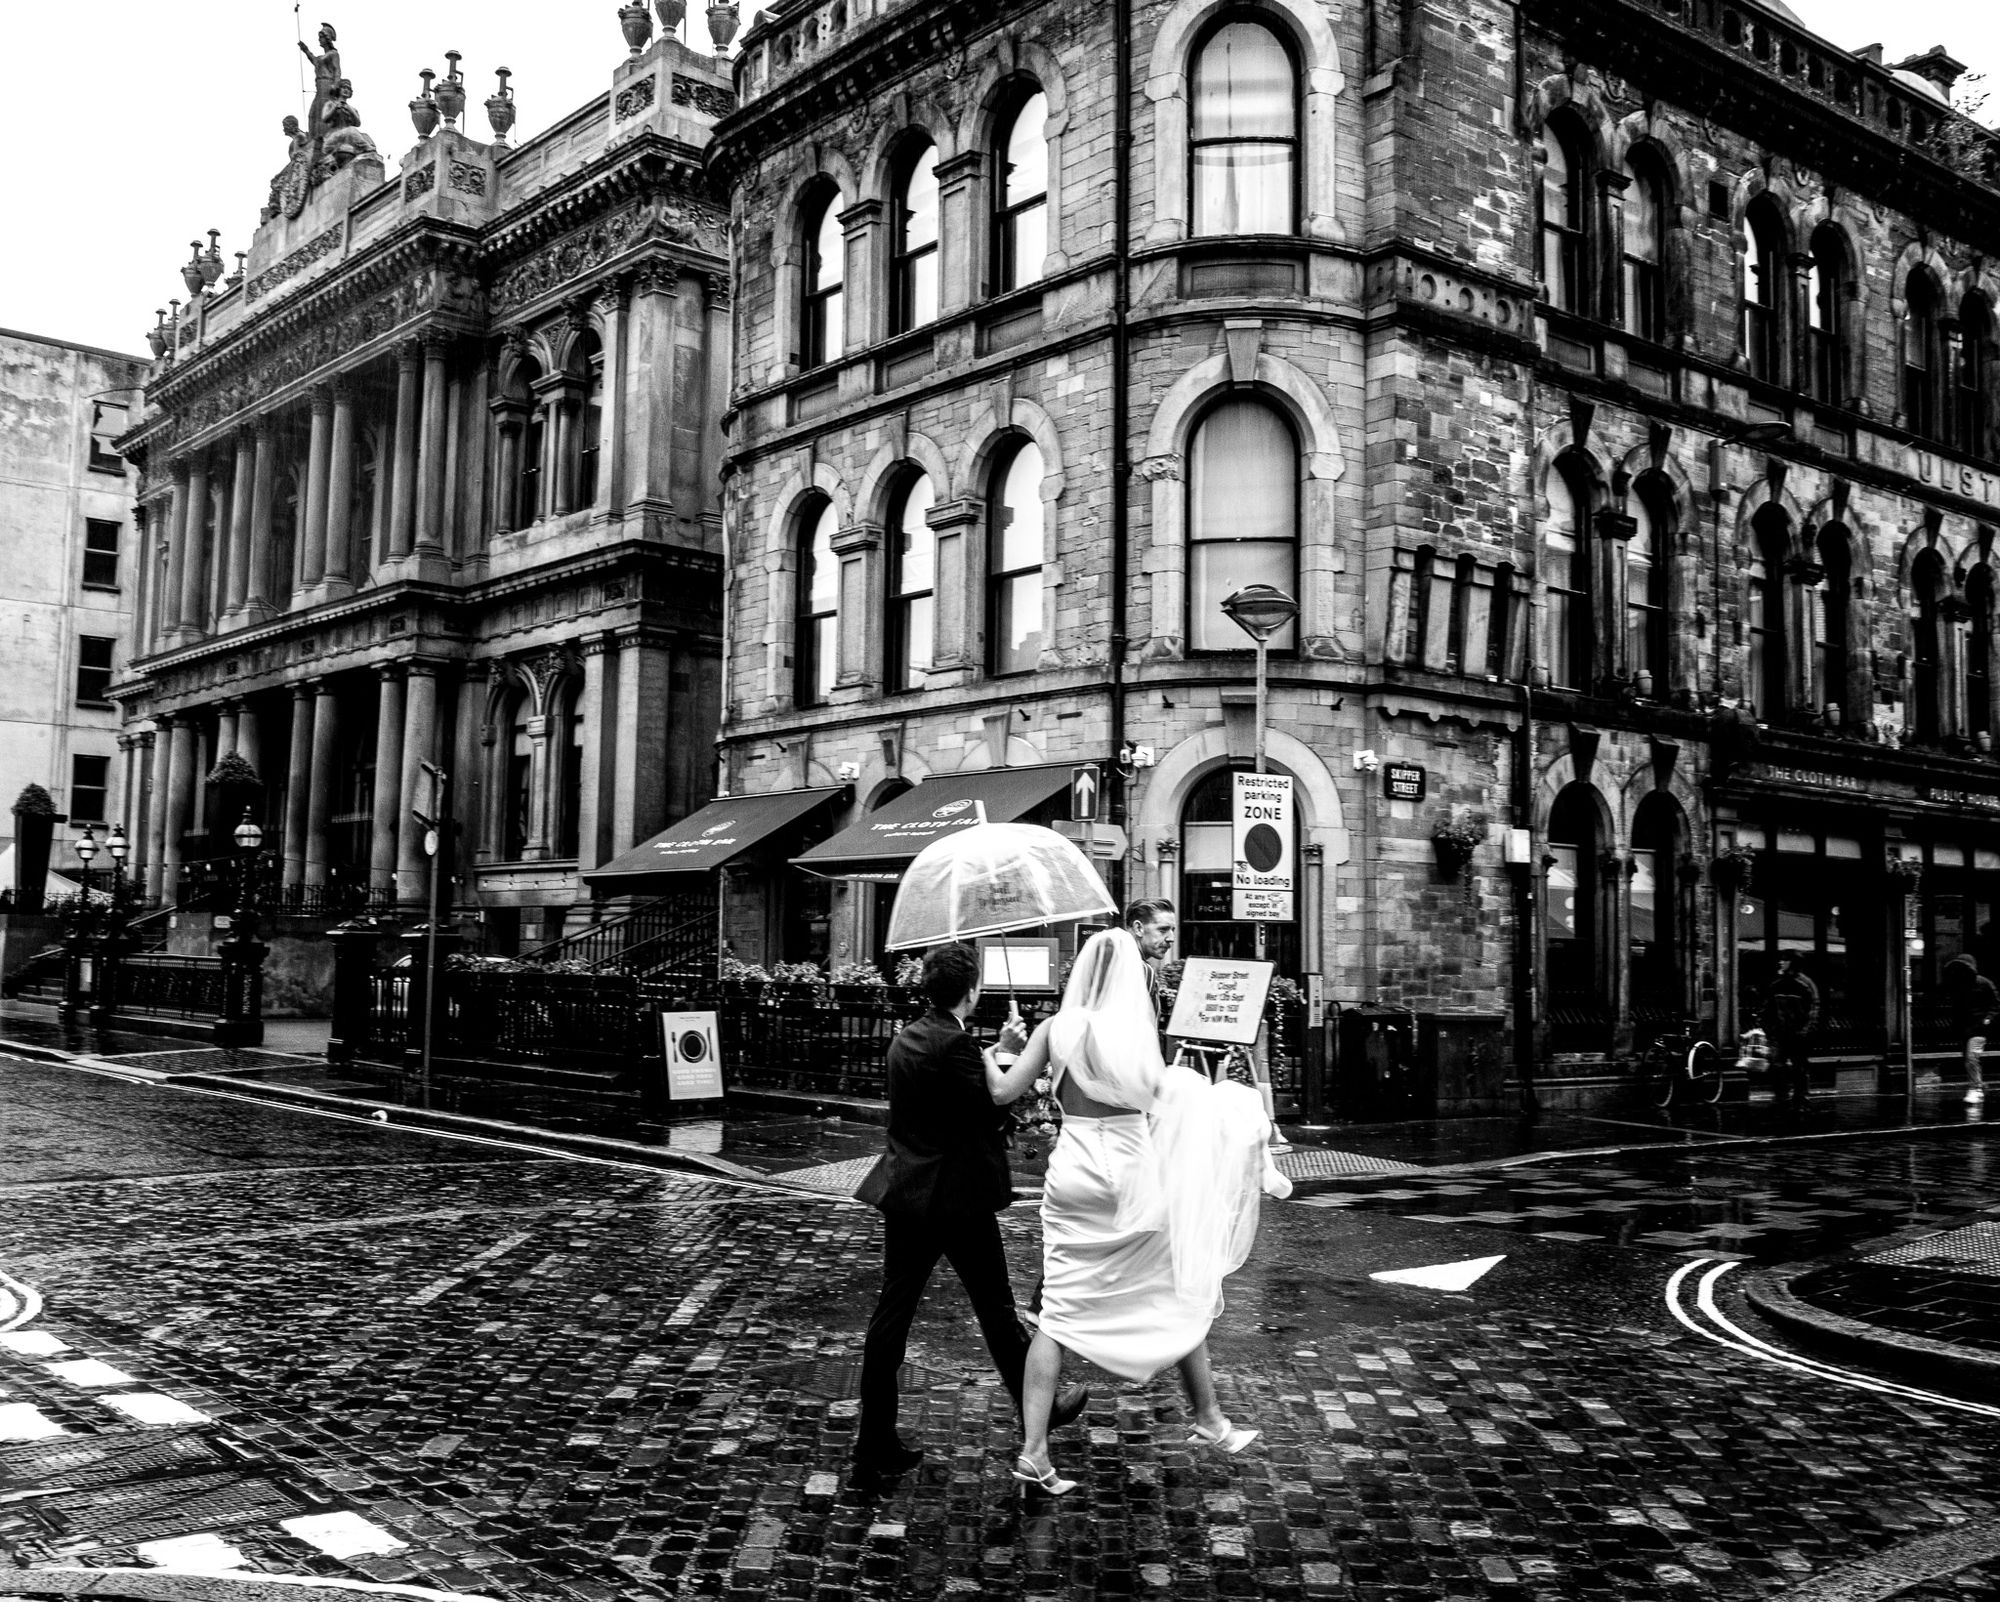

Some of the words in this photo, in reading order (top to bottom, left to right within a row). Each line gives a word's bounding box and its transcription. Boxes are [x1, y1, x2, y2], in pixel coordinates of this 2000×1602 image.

[1238, 775, 1289, 789] Restricted
[1391, 768, 1420, 782] SKIPPER
[1768, 765, 1791, 780] THE
[1794, 769, 1833, 786] CLOTH
[1836, 775, 1858, 791] EAR
[1392, 781, 1418, 794] STREET
[1244, 790, 1282, 804] parking
[1930, 787, 1964, 803] PUBLIC
[1244, 805, 1282, 820] ZONE
[870, 822, 901, 830] THE
[901, 819, 952, 829] CLOTH
[1236, 873, 1250, 885] No
[1254, 875, 1290, 888] loading
[1248, 902, 1270, 910] except
[1246, 910, 1266, 918] signed
